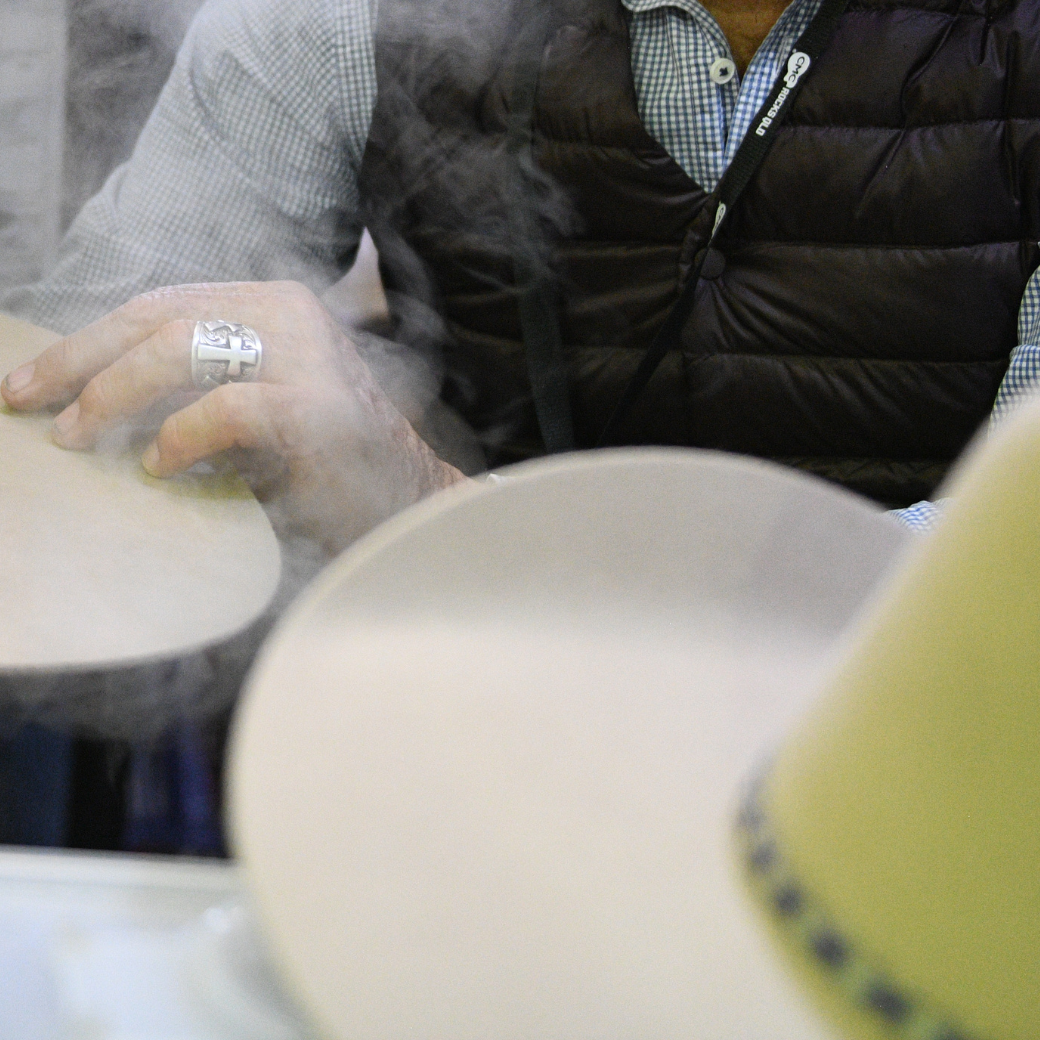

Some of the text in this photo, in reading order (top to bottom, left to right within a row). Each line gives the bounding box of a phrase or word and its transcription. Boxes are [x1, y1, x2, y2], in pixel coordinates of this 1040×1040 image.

[788, 56, 805, 83] CMC
[755, 86, 790, 136] ROCKS QLD
